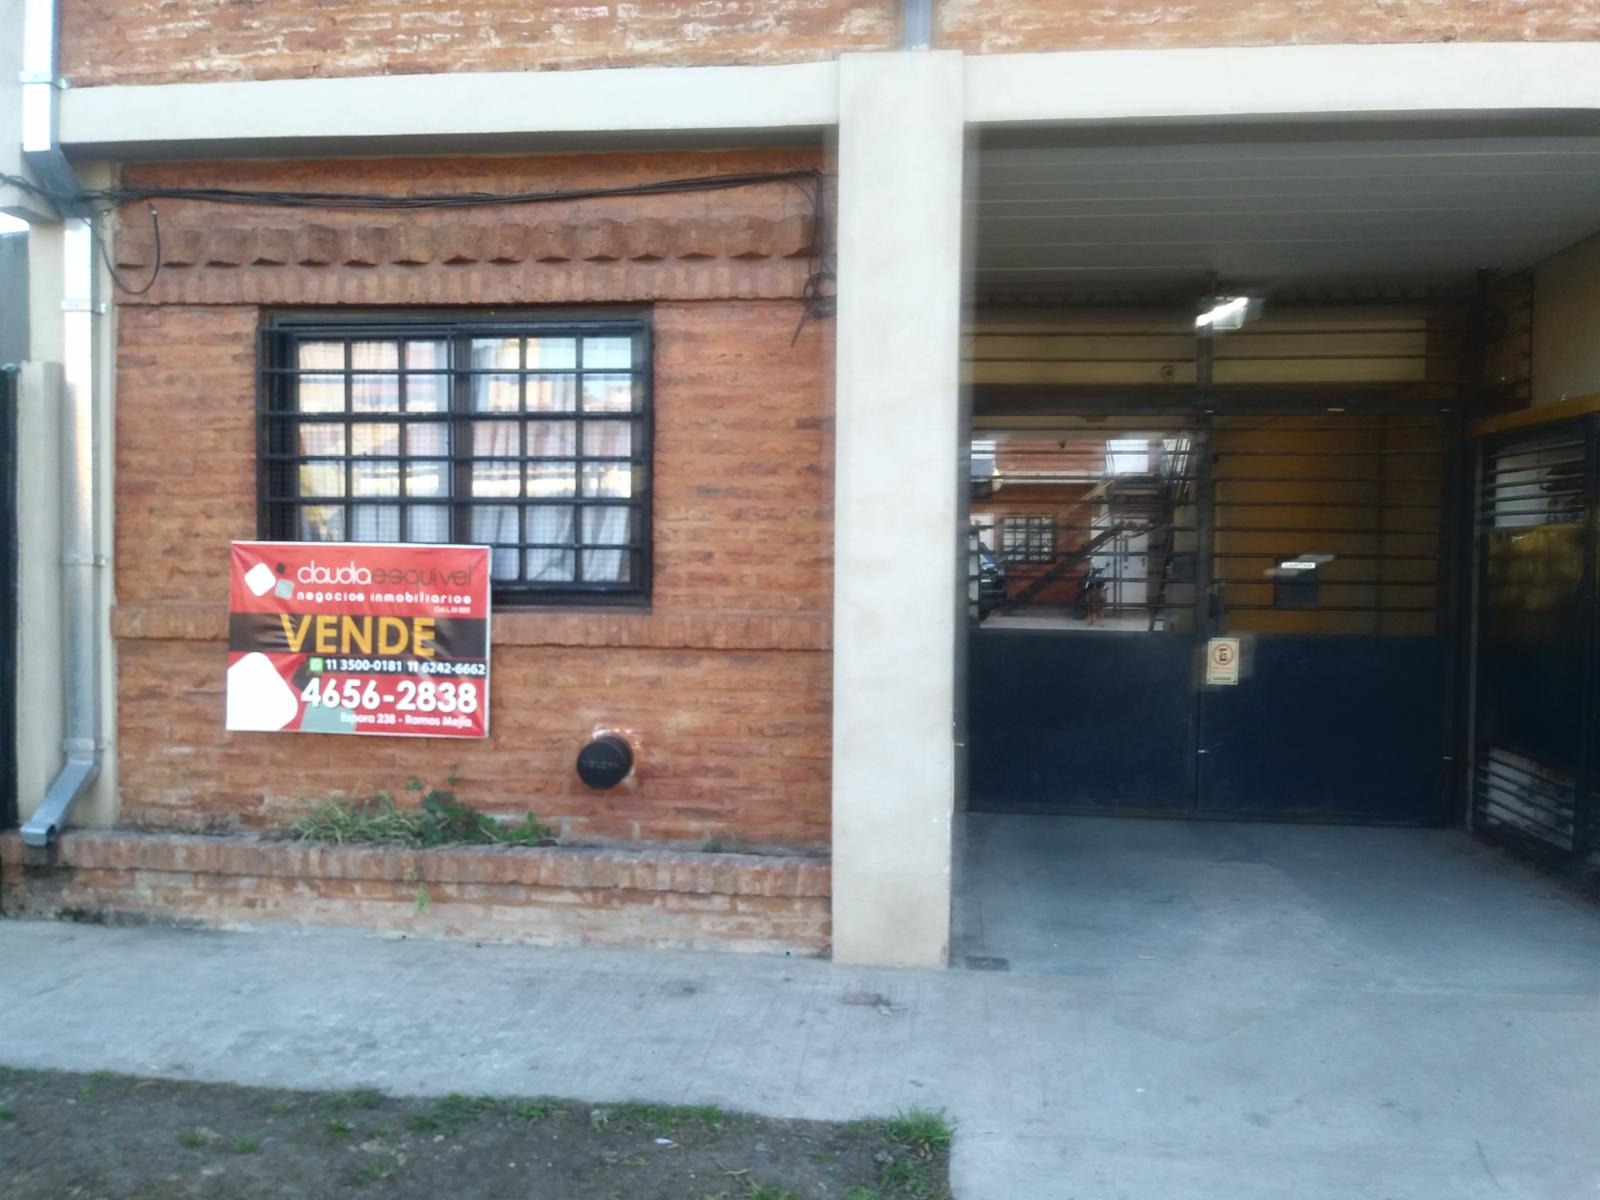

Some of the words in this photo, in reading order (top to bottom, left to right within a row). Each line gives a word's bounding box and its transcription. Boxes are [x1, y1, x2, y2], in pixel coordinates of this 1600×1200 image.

[296, 591, 366, 603] negocios
[369, 591, 473, 605] inmobiliarios
[280, 614, 435, 657] VENDE
[325, 659, 338, 671] 11
[340, 660, 402, 671] 3500-0181
[407, 661, 419, 673] 11
[421, 662, 486, 676] 6242-6662
[301, 677, 477, 713] 4656-2838
[377, 713, 396, 725] 238
[404, 714, 441, 727] Ramos
